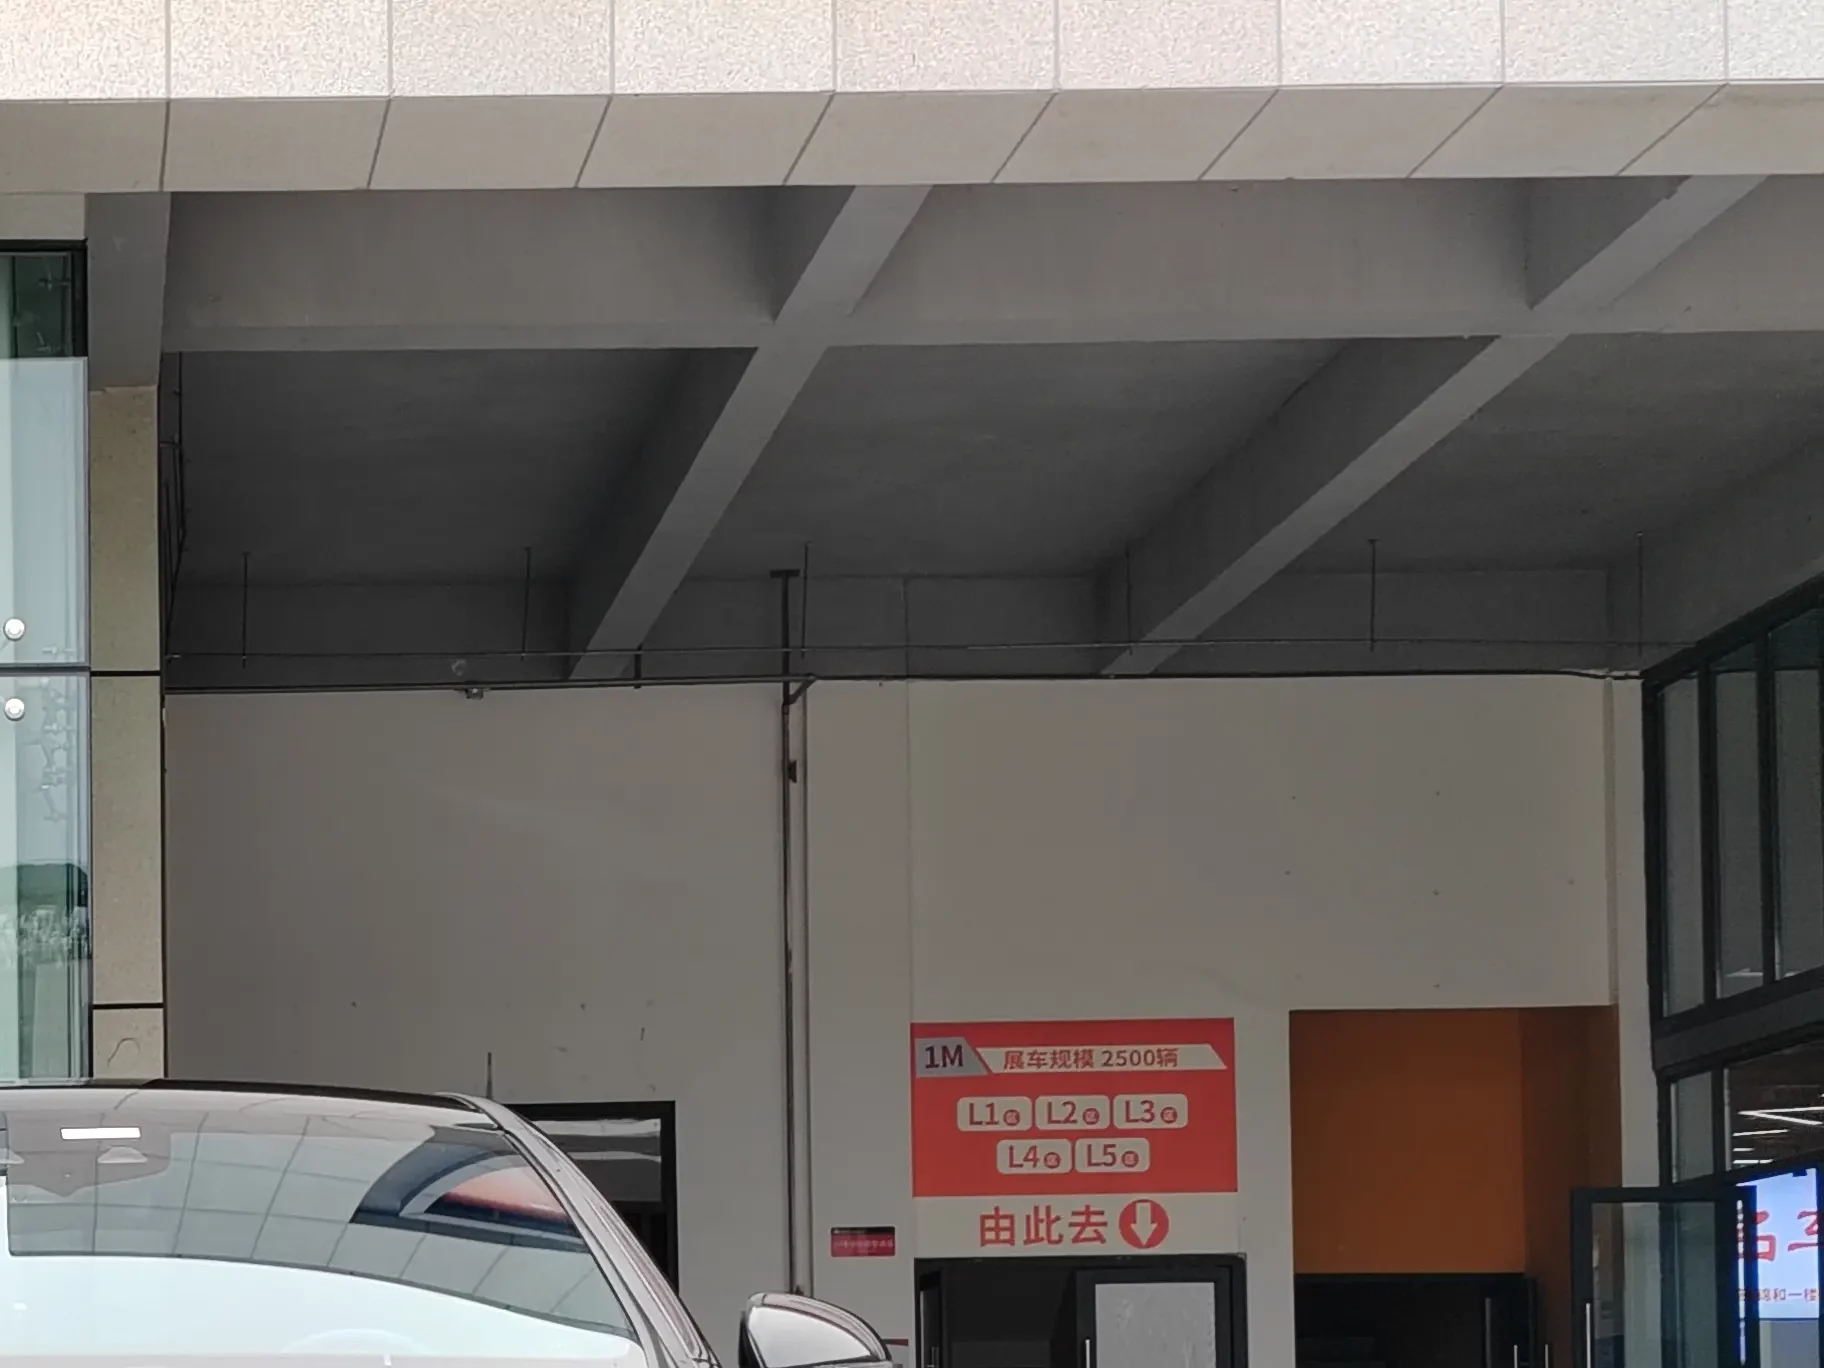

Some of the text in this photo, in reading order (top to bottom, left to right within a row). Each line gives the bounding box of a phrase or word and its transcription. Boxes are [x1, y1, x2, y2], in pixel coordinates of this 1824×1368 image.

[924, 1044, 964, 1069] 1M
[1003, 1047, 1180, 1071] 展车规模 2500辆
[979, 1205, 1109, 1247] 由此去
